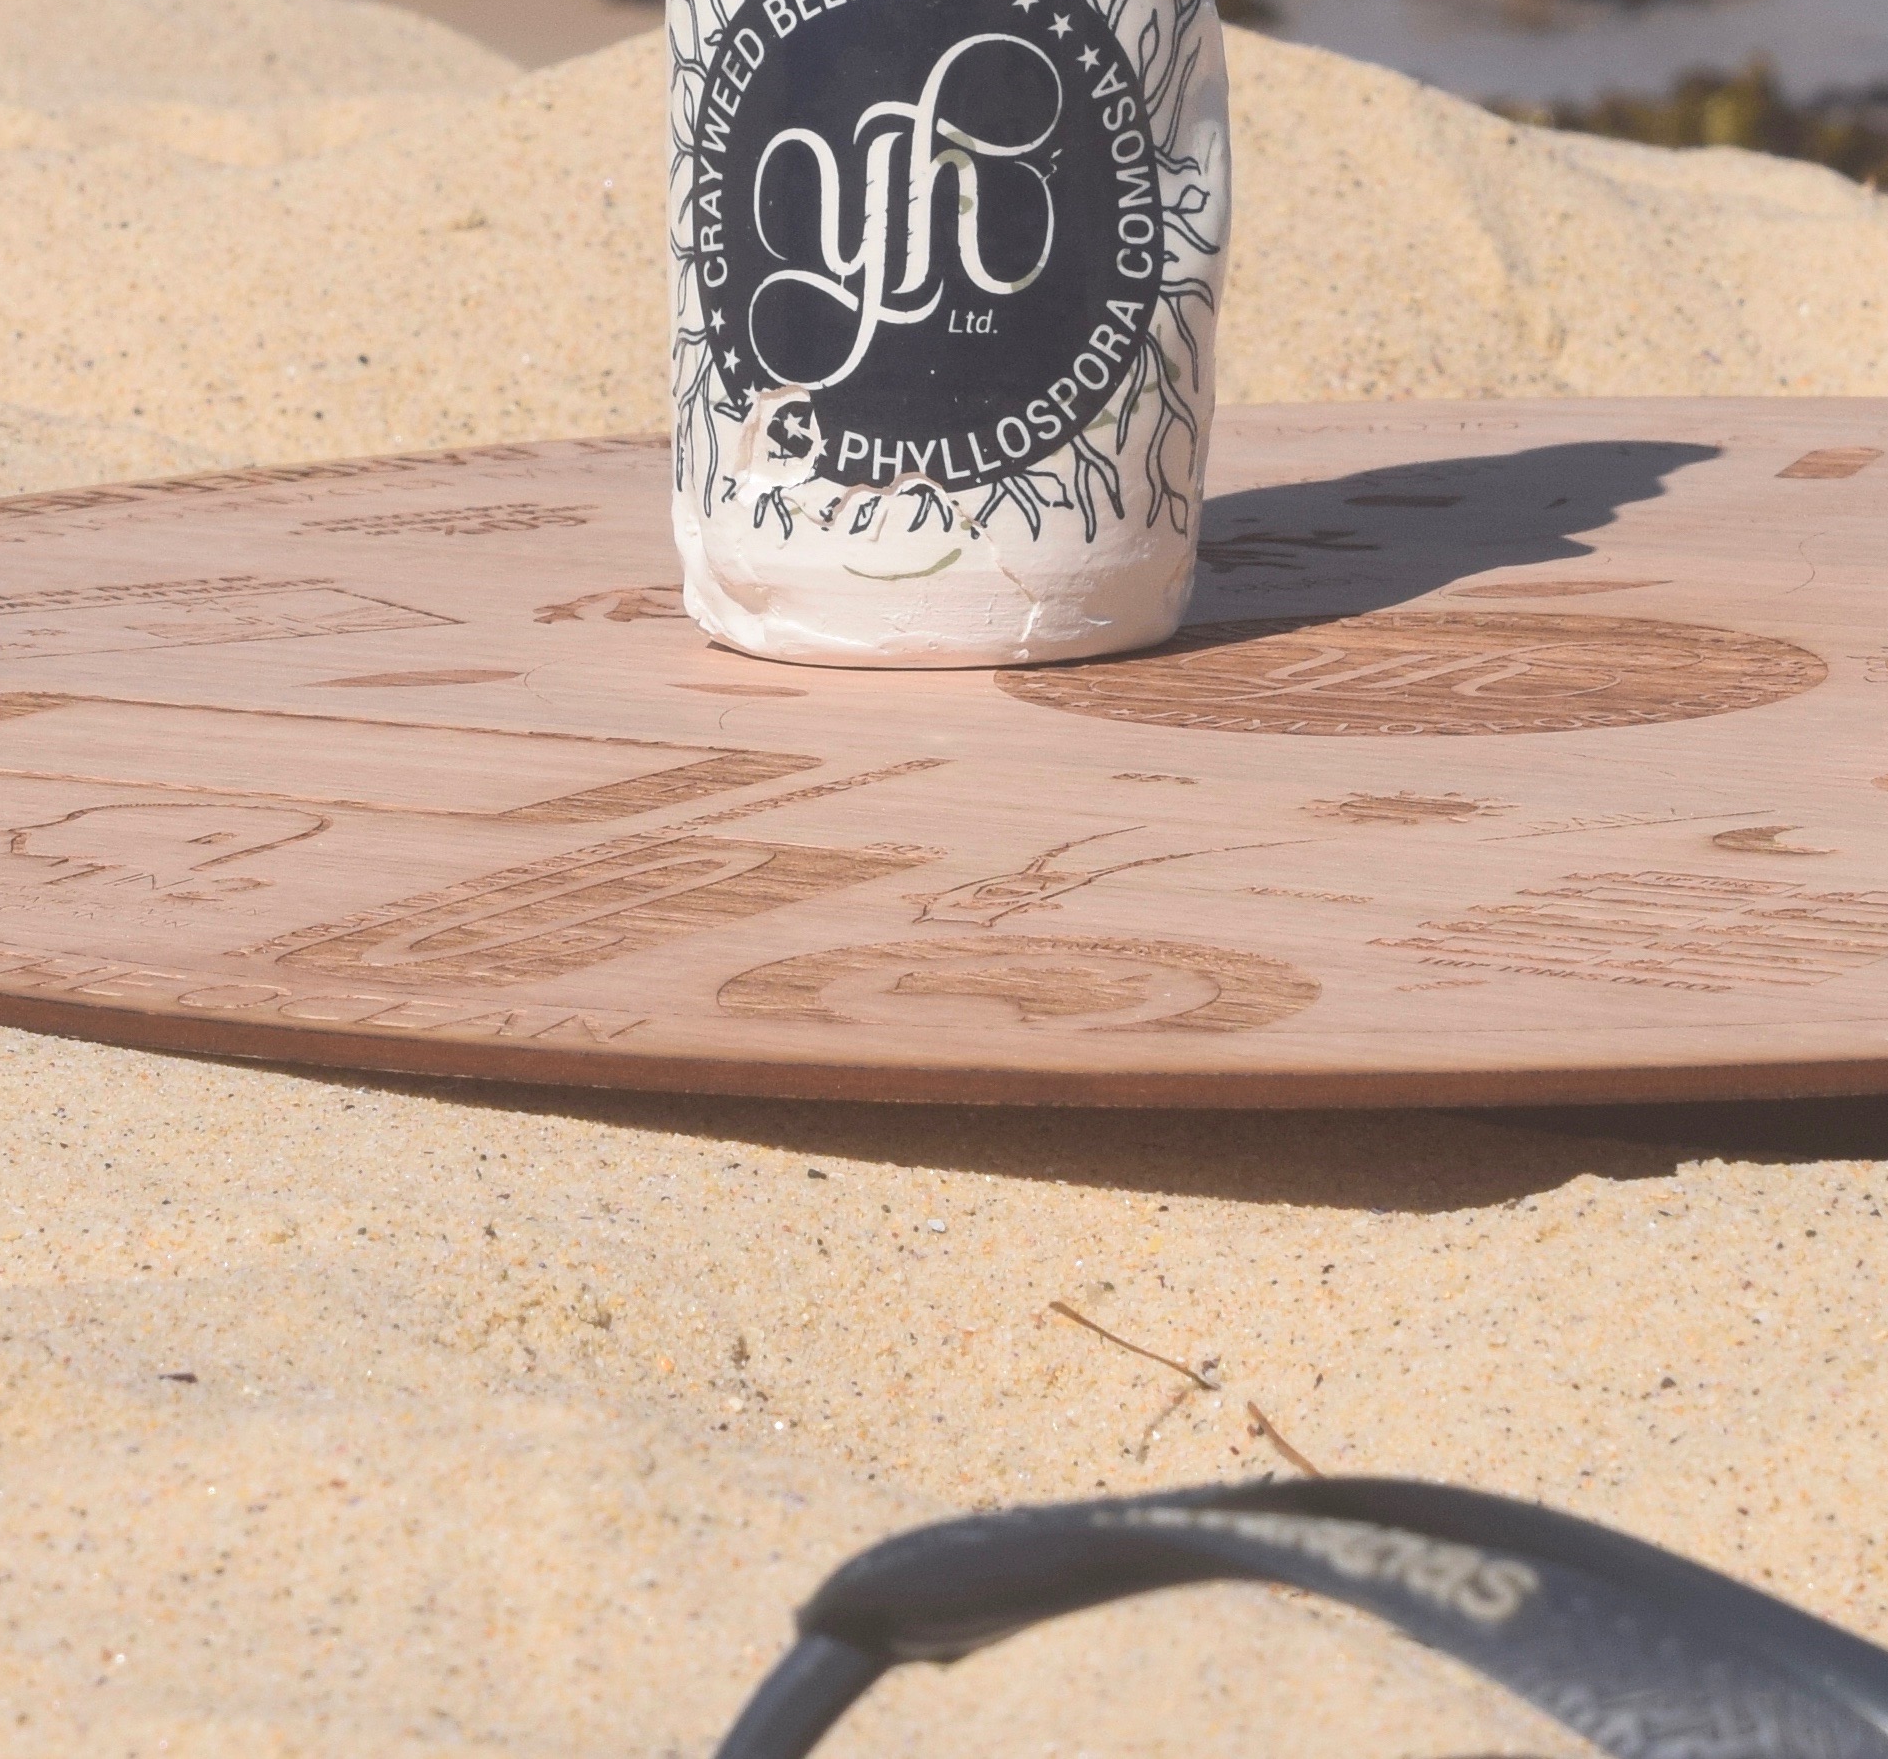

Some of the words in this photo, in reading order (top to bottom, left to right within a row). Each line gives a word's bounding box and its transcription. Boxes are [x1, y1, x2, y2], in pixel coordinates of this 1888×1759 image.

[699, 29, 766, 287] CRAYWEED
[835, 299, 1145, 482] PHYLLOSPORA
[1090, 61, 1156, 280] COMOSA
[948, 308, 999, 335] Ltd.
[176, 983, 652, 1044] OCEAN
